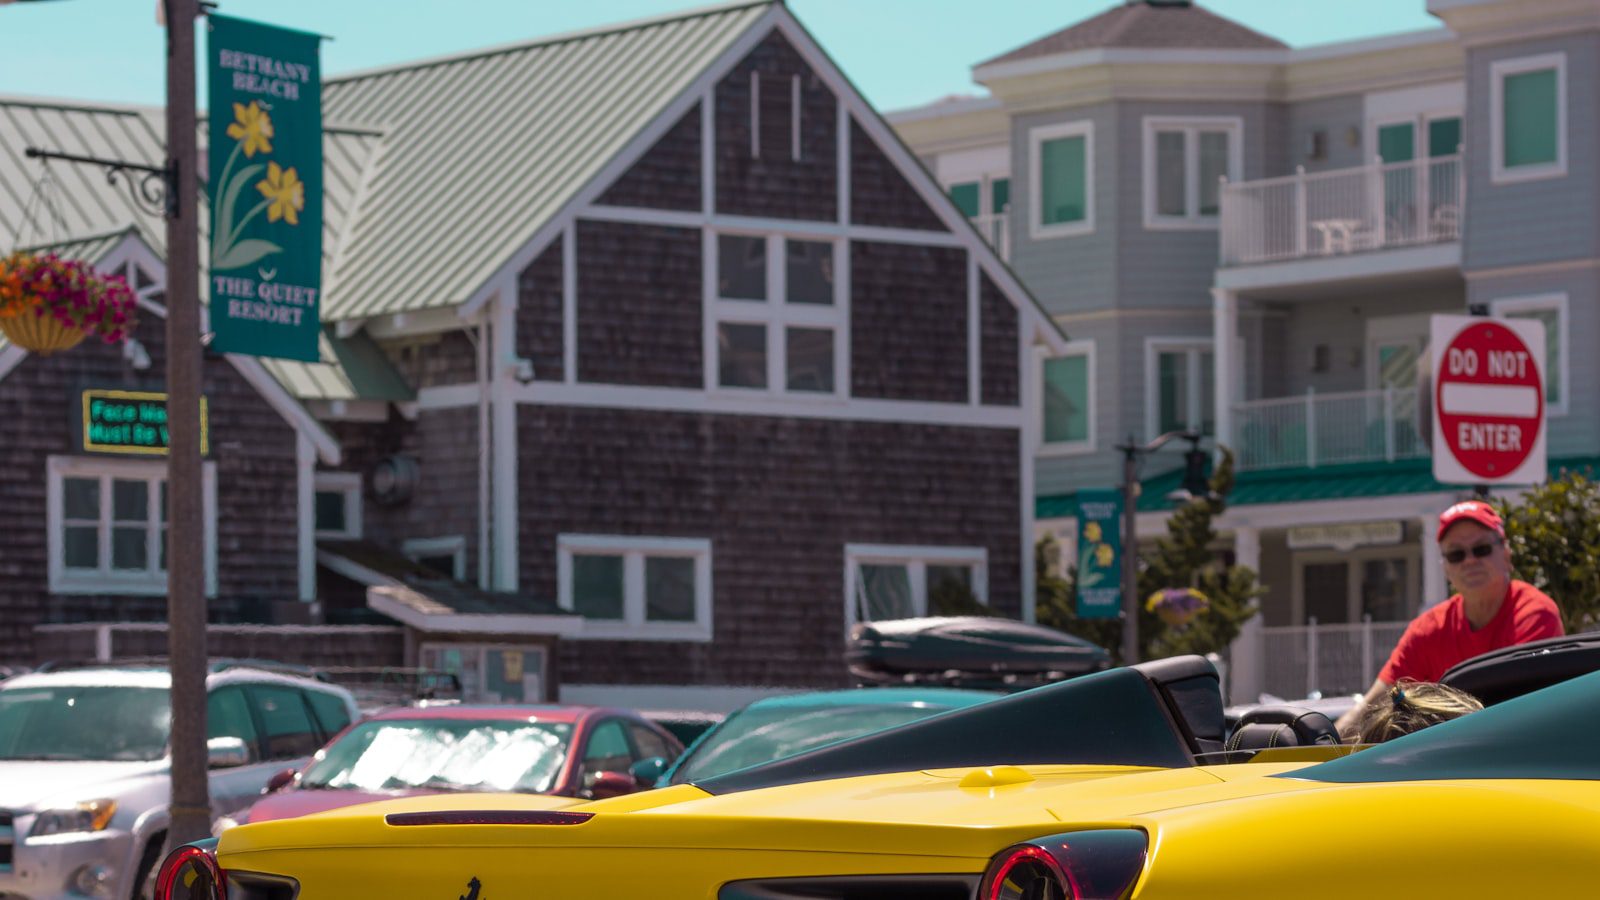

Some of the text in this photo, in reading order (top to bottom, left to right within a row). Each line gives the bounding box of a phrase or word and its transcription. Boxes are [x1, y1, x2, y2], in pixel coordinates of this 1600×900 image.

[219, 49, 310, 83] BETHANY
[233, 72, 299, 100] BEACH
[213, 276, 317, 307] THE QUIET
[228, 299, 304, 326] RESORT
[1449, 348, 1528, 378] DO NOT
[91, 400, 137, 422] Face
[1458, 422, 1521, 451] ENTER
